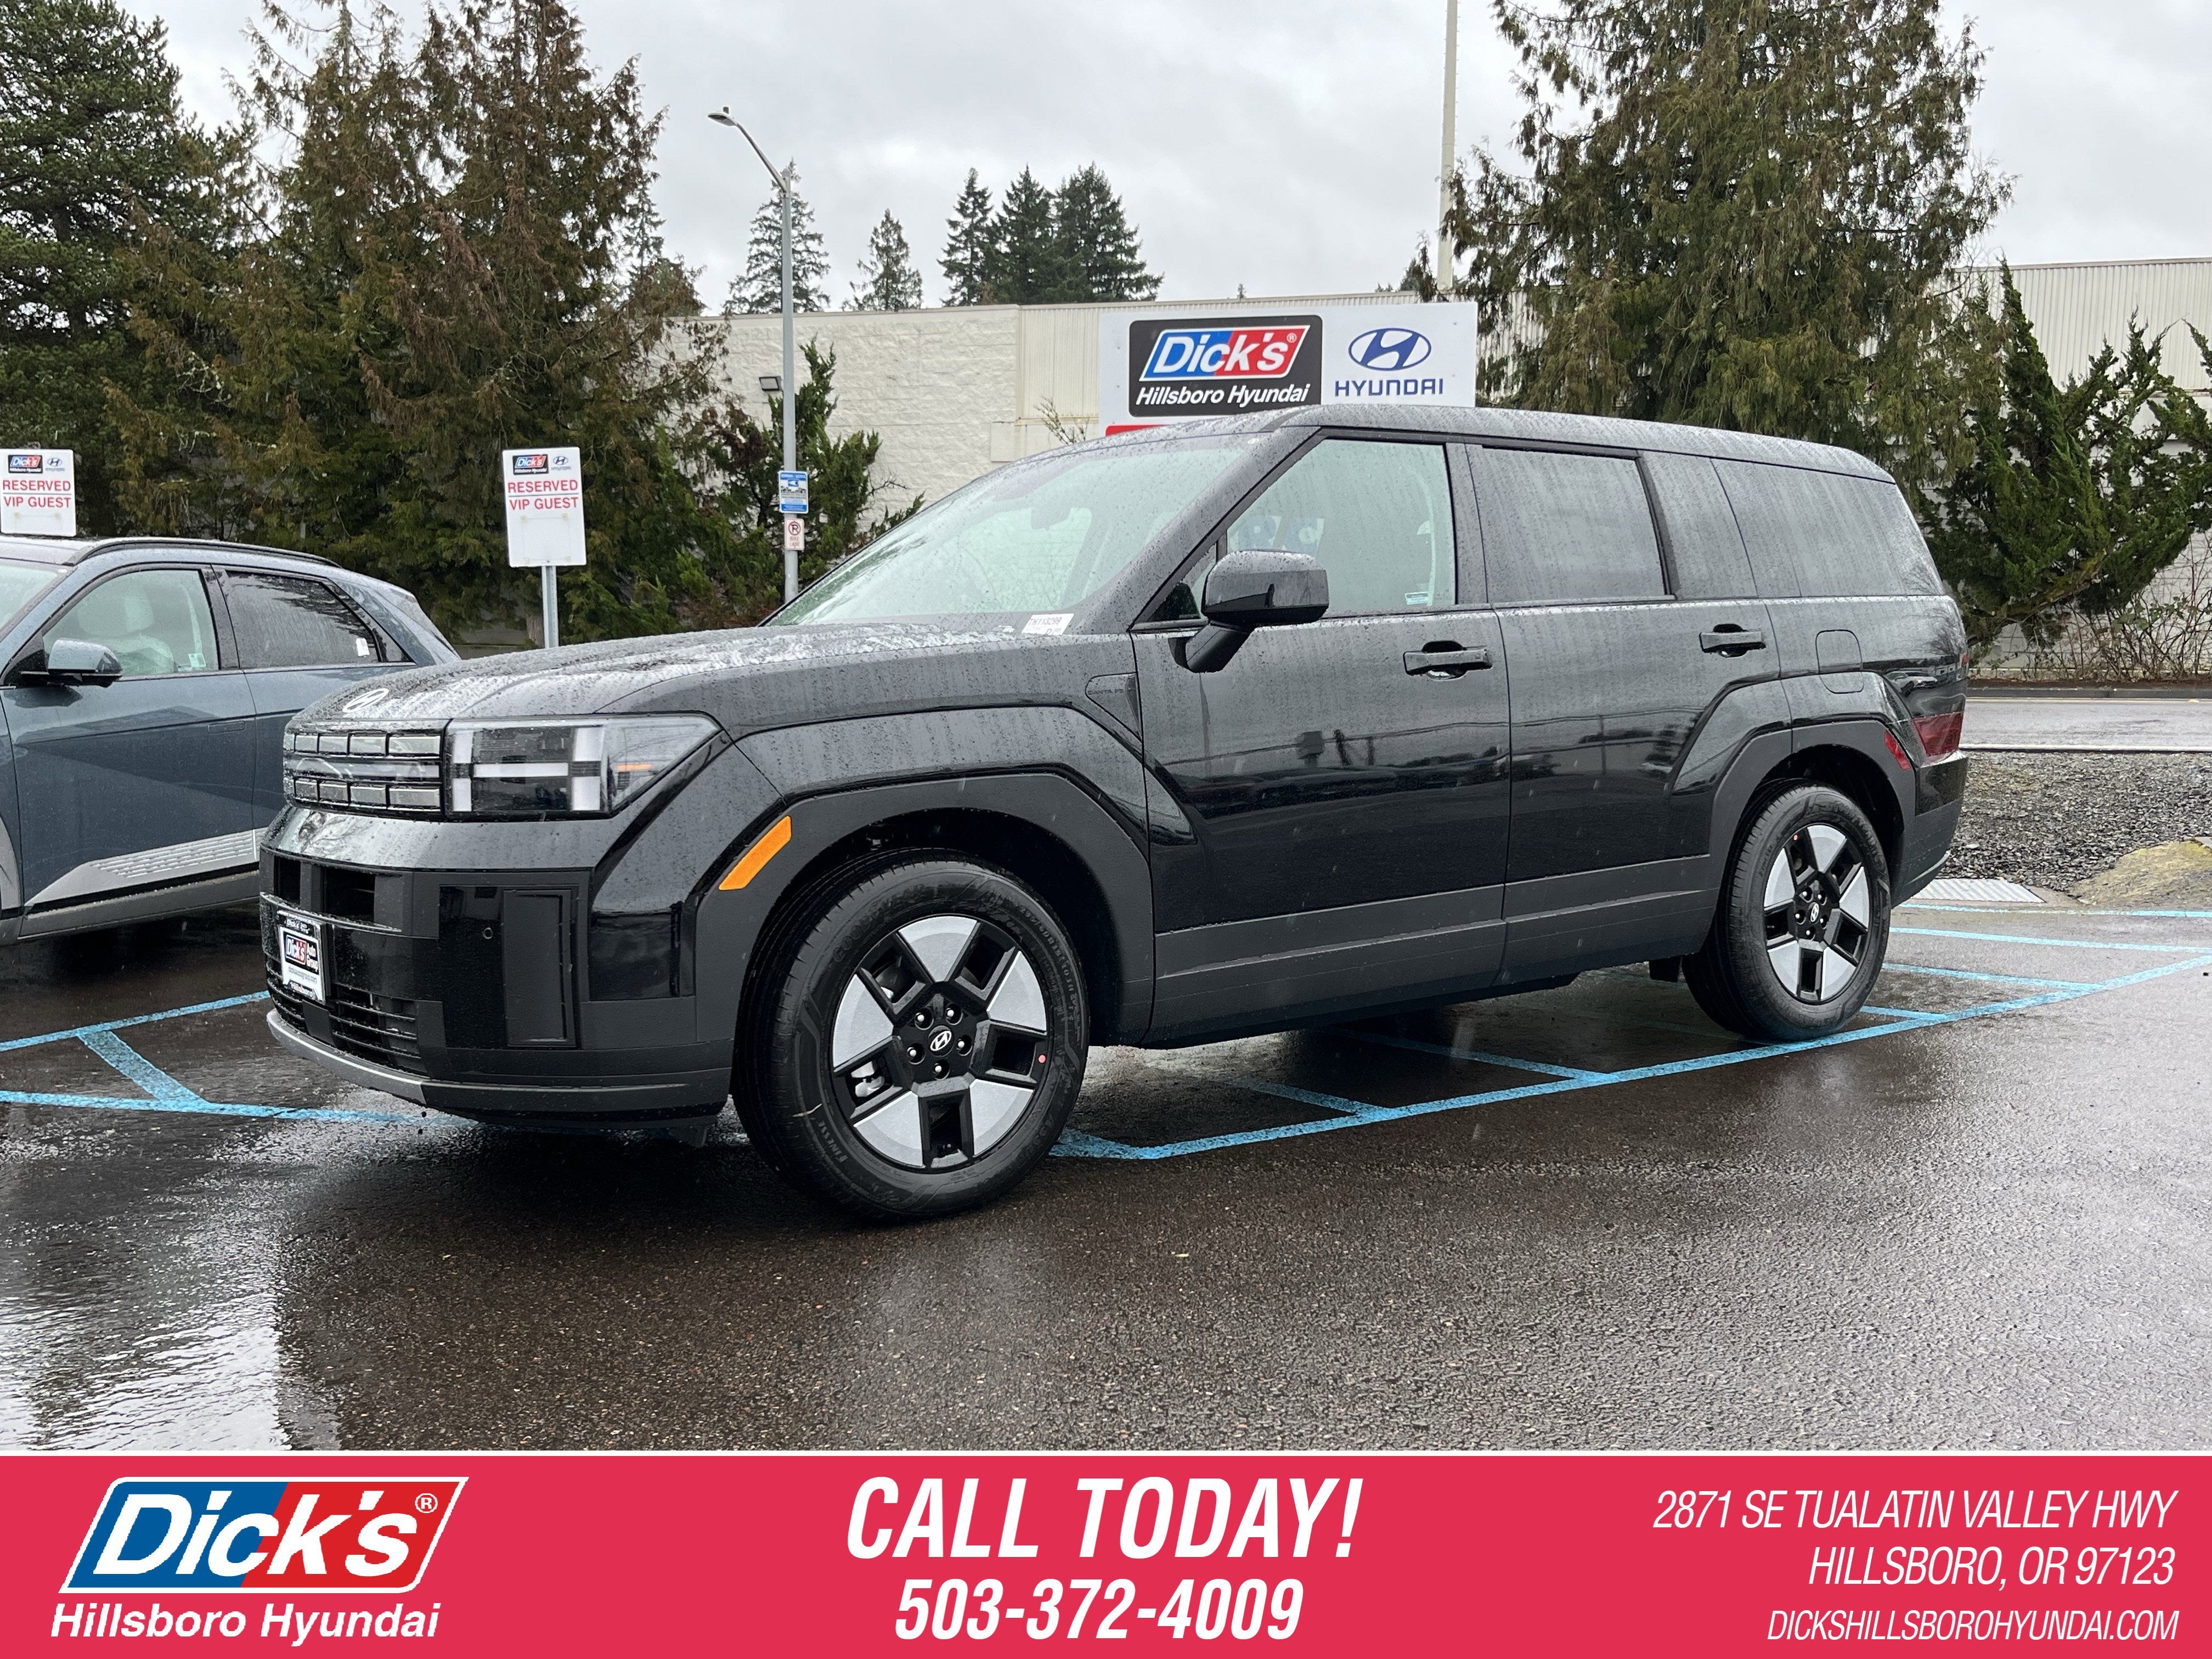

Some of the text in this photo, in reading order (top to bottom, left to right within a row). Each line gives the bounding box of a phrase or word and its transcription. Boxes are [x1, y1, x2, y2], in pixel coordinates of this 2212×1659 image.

[1153, 332, 1289, 374] Dick's
[1136, 383, 1311, 408] Hillsboro Hyundai
[1335, 378, 1443, 397] HYUNDAI
[3, 480, 71, 492] RESERVED
[507, 479, 578, 493] RESERVED
[3, 496, 71, 508] VIP GUEST
[509, 497, 579, 510] VIP GUEST
[287, 938, 305, 961] Dick's
